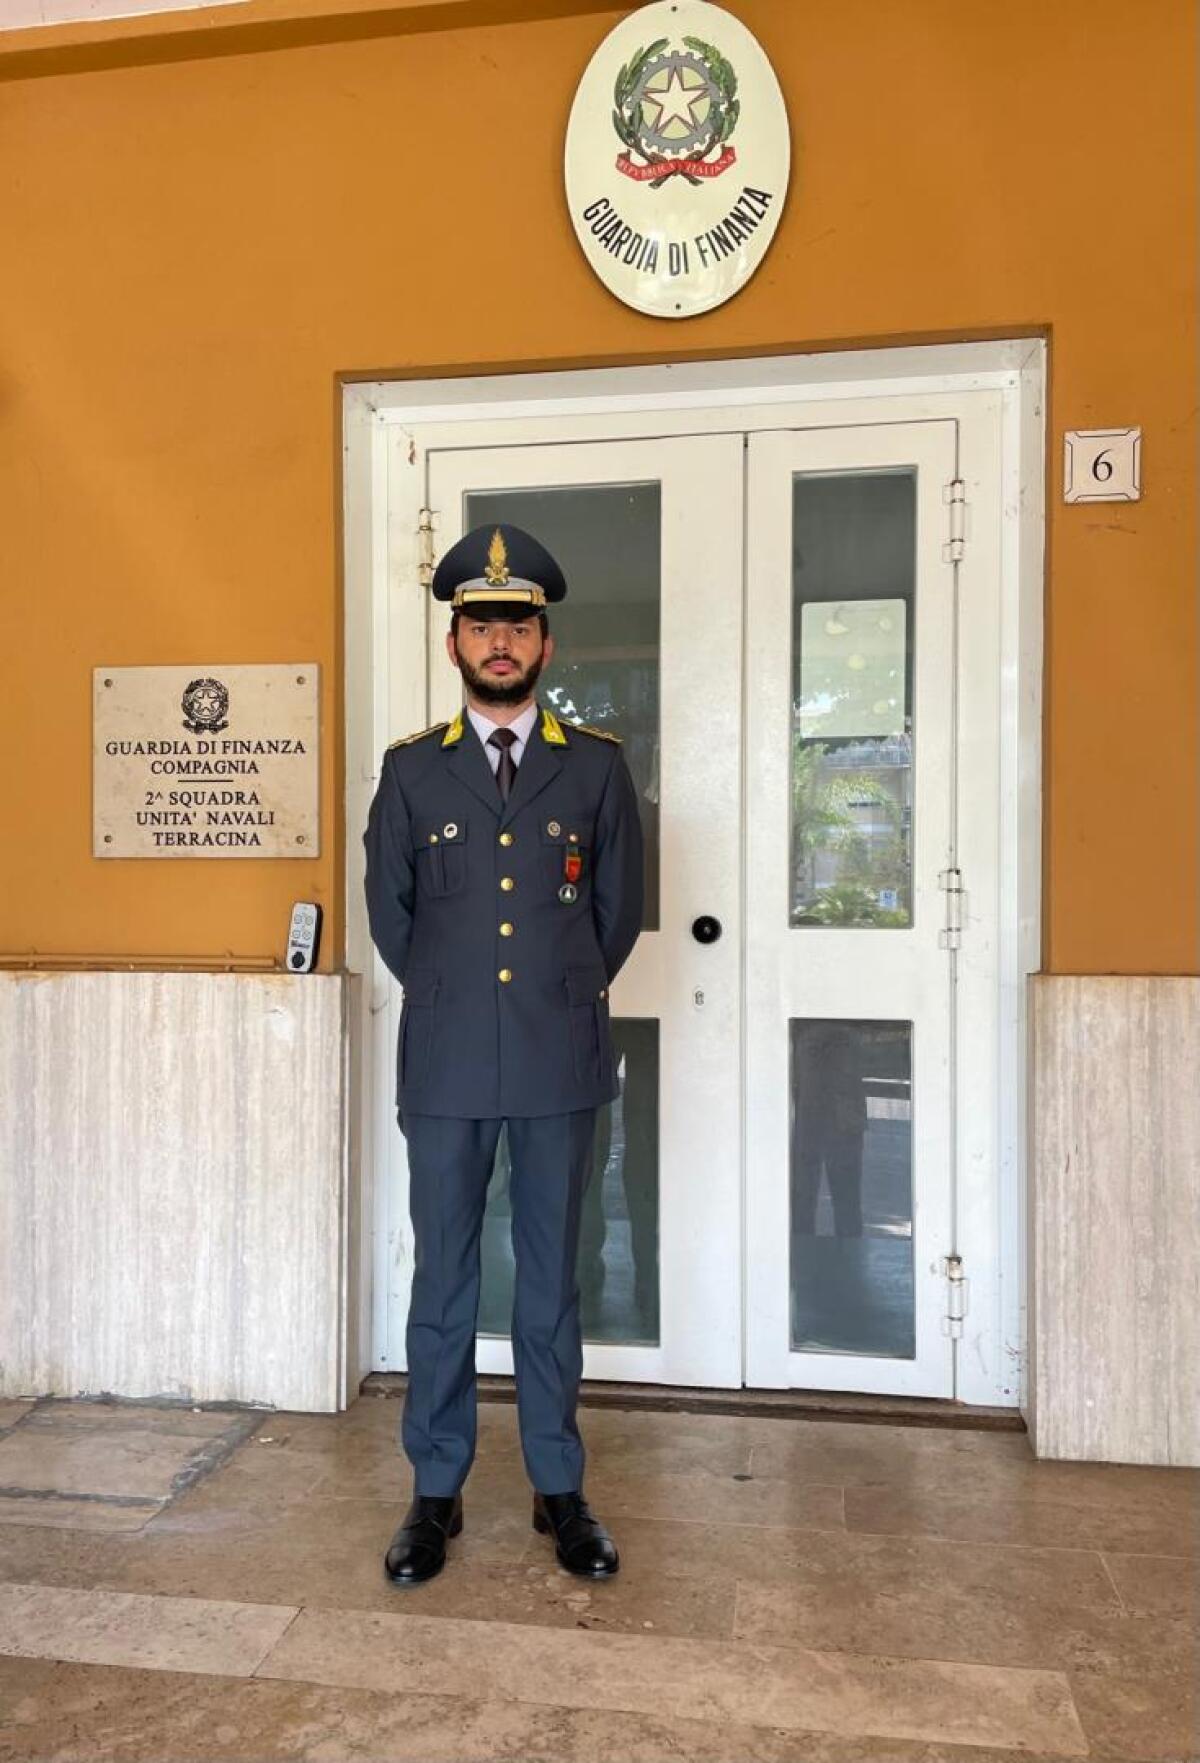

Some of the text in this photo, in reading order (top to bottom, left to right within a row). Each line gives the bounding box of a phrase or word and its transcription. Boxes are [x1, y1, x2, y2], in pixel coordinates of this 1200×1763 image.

[583, 187, 773, 276] GUARDIA DI FINANZA
[1092, 448, 1113, 482] 6
[105, 740, 306, 755] GUARDIA DI FINANZA
[150, 760, 259, 774] COMPAGNIA
[169, 791, 261, 808] SQUADRA
[136, 811, 275, 825] UNITA' NAVALI
[152, 832, 261, 846] TERRACINA
